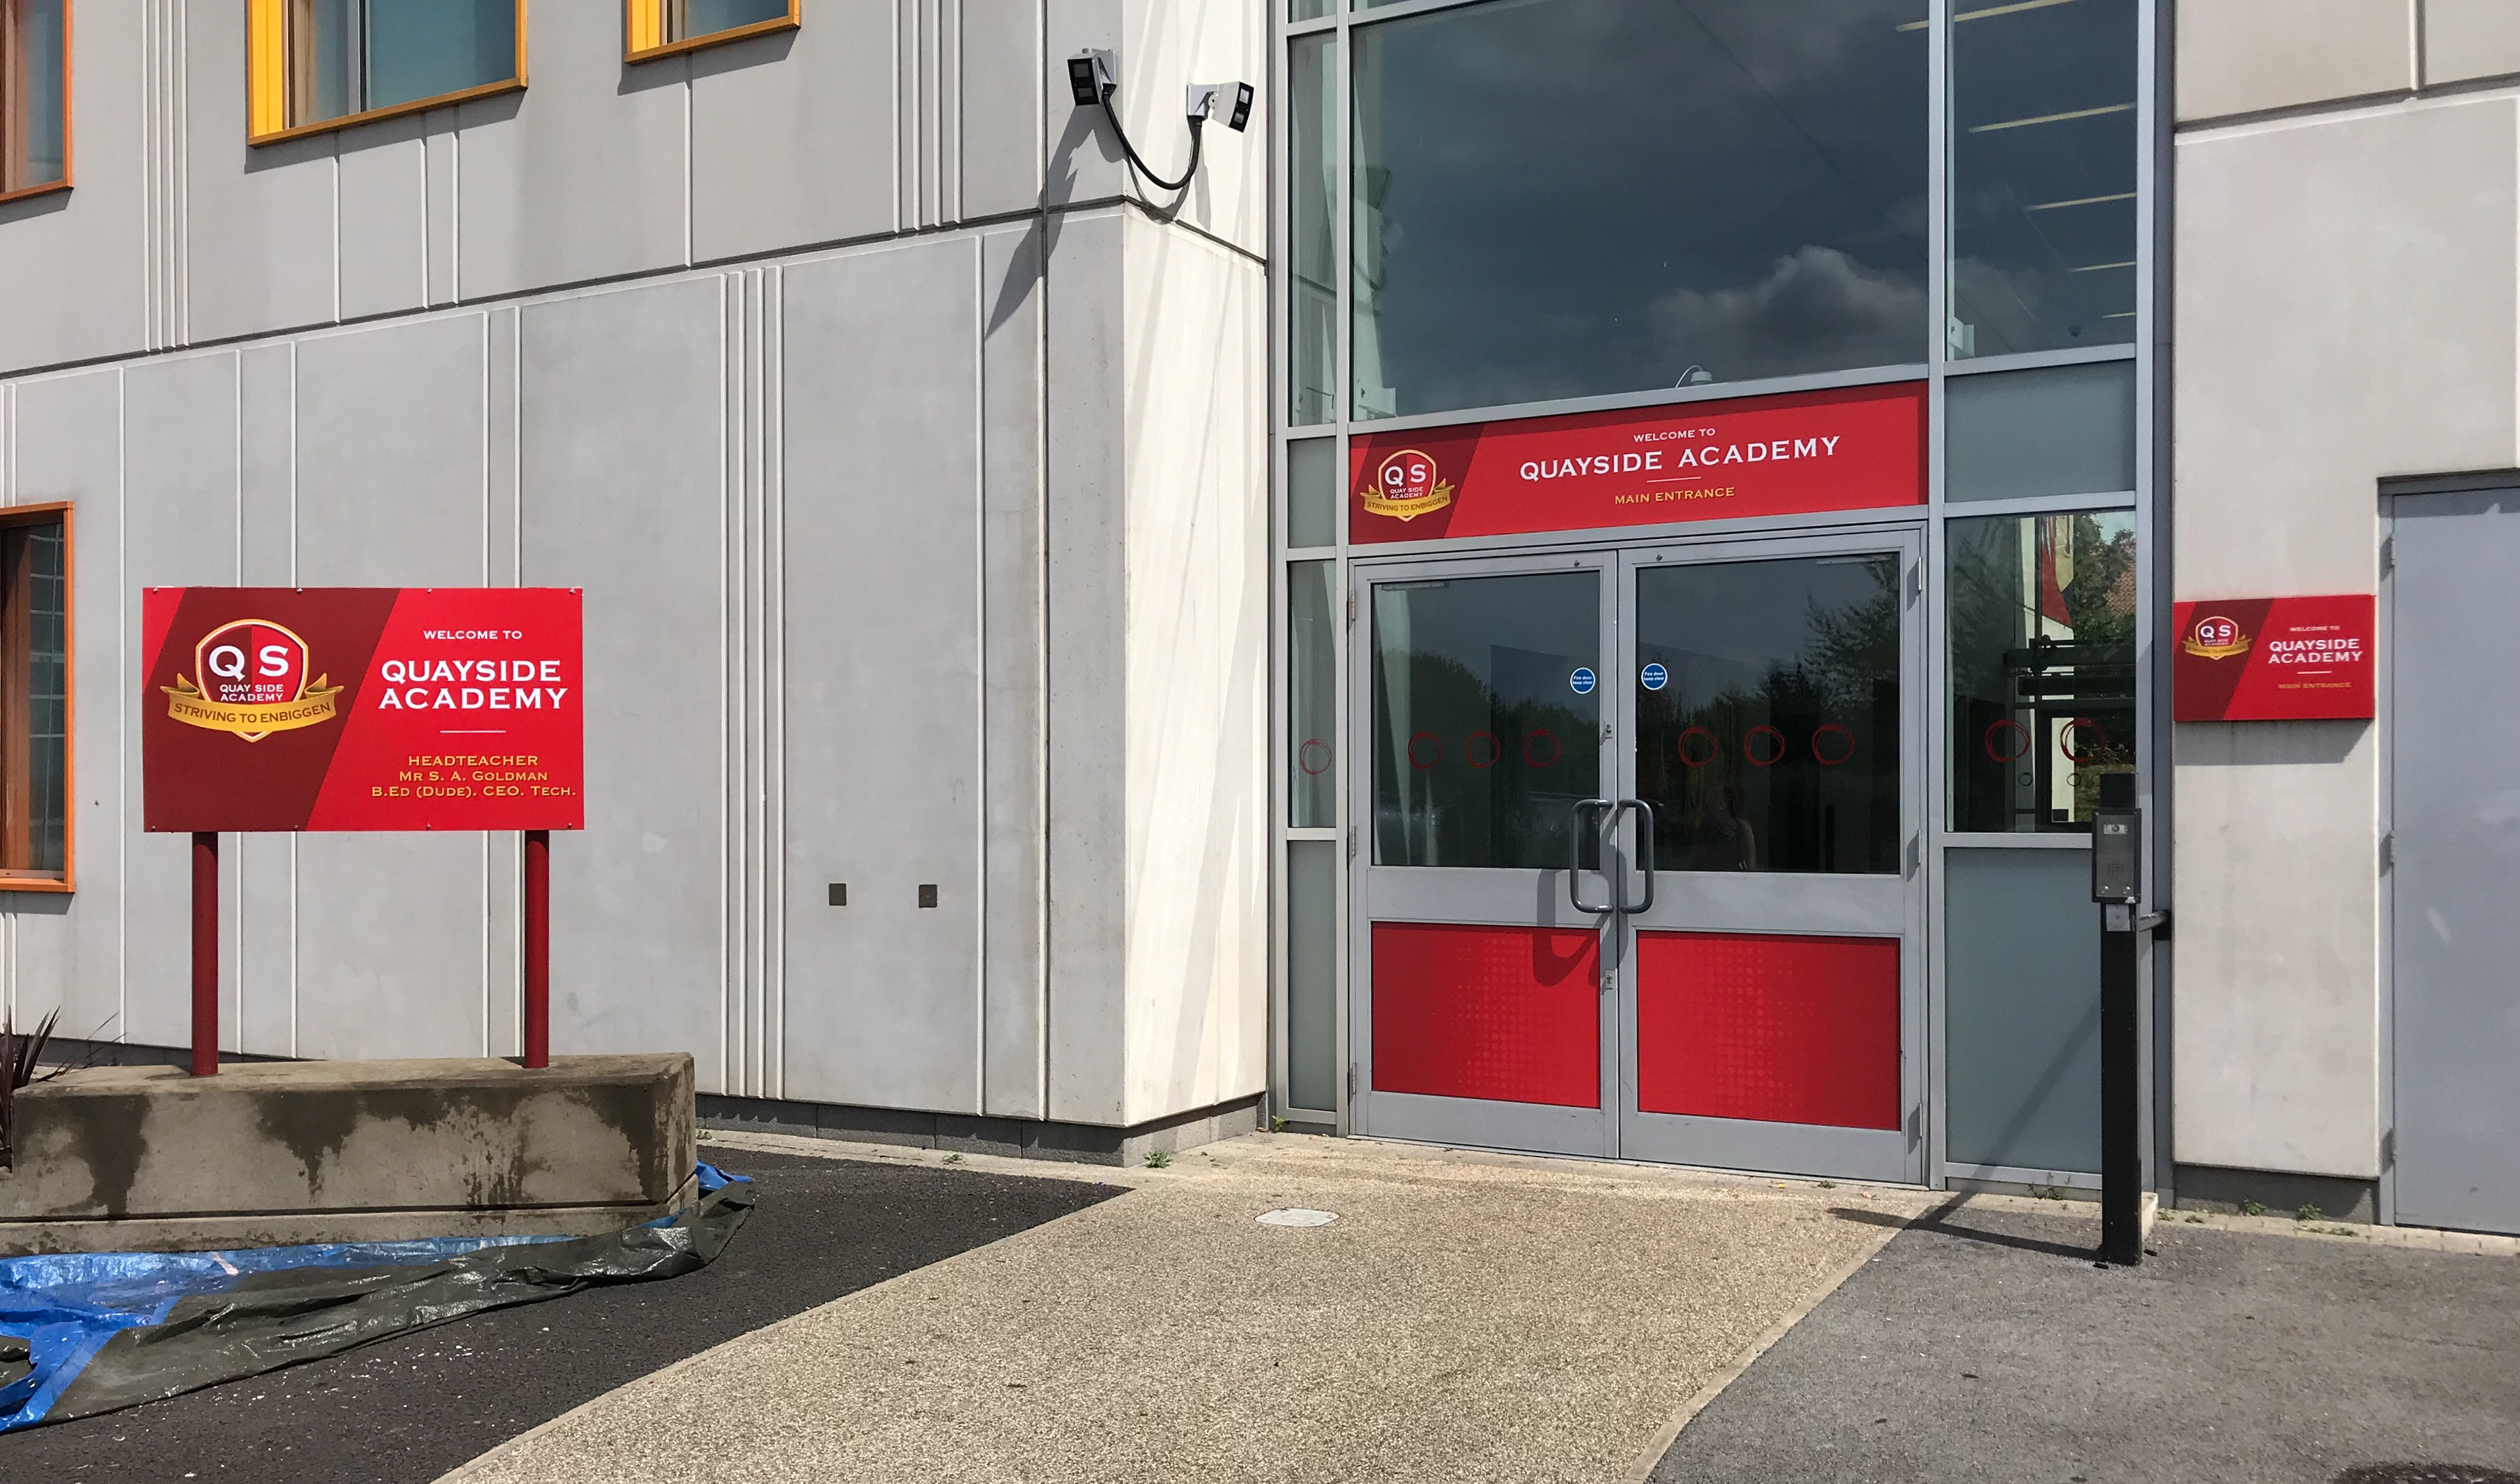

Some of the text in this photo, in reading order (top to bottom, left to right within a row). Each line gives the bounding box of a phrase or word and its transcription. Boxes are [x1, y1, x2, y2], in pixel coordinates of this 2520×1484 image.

[1633, 428, 1716, 442] WELCOME TO
[1520, 435, 1840, 482] QUAYSIDE ACADEMY
[1385, 463, 1426, 487] Q S
[1615, 487, 1735, 505] MAIN ENTRANCE
[1367, 501, 1398, 511] STRIVING
[1410, 496, 1448, 510] ENBIGGEN
[423, 630, 522, 640] WELCOME TO
[2269, 639, 2359, 652] QUAYSIDE
[209, 645, 289, 682] Q S
[2268, 651, 2362, 664] ACADEMY
[381, 660, 561, 683] QUAYSIDE
[219, 684, 284, 693] QUAY SIDE
[220, 693, 284, 702] ACADEMY
[378, 687, 568, 710] ACADEMY
[174, 702, 331, 723] STRIVING TO ENBIGGEN
[408, 755, 539, 767] HEADTEACHER
[429, 771, 445, 782] S.
[450, 771, 466, 782] A.
[483, 786, 524, 797] CEO.
